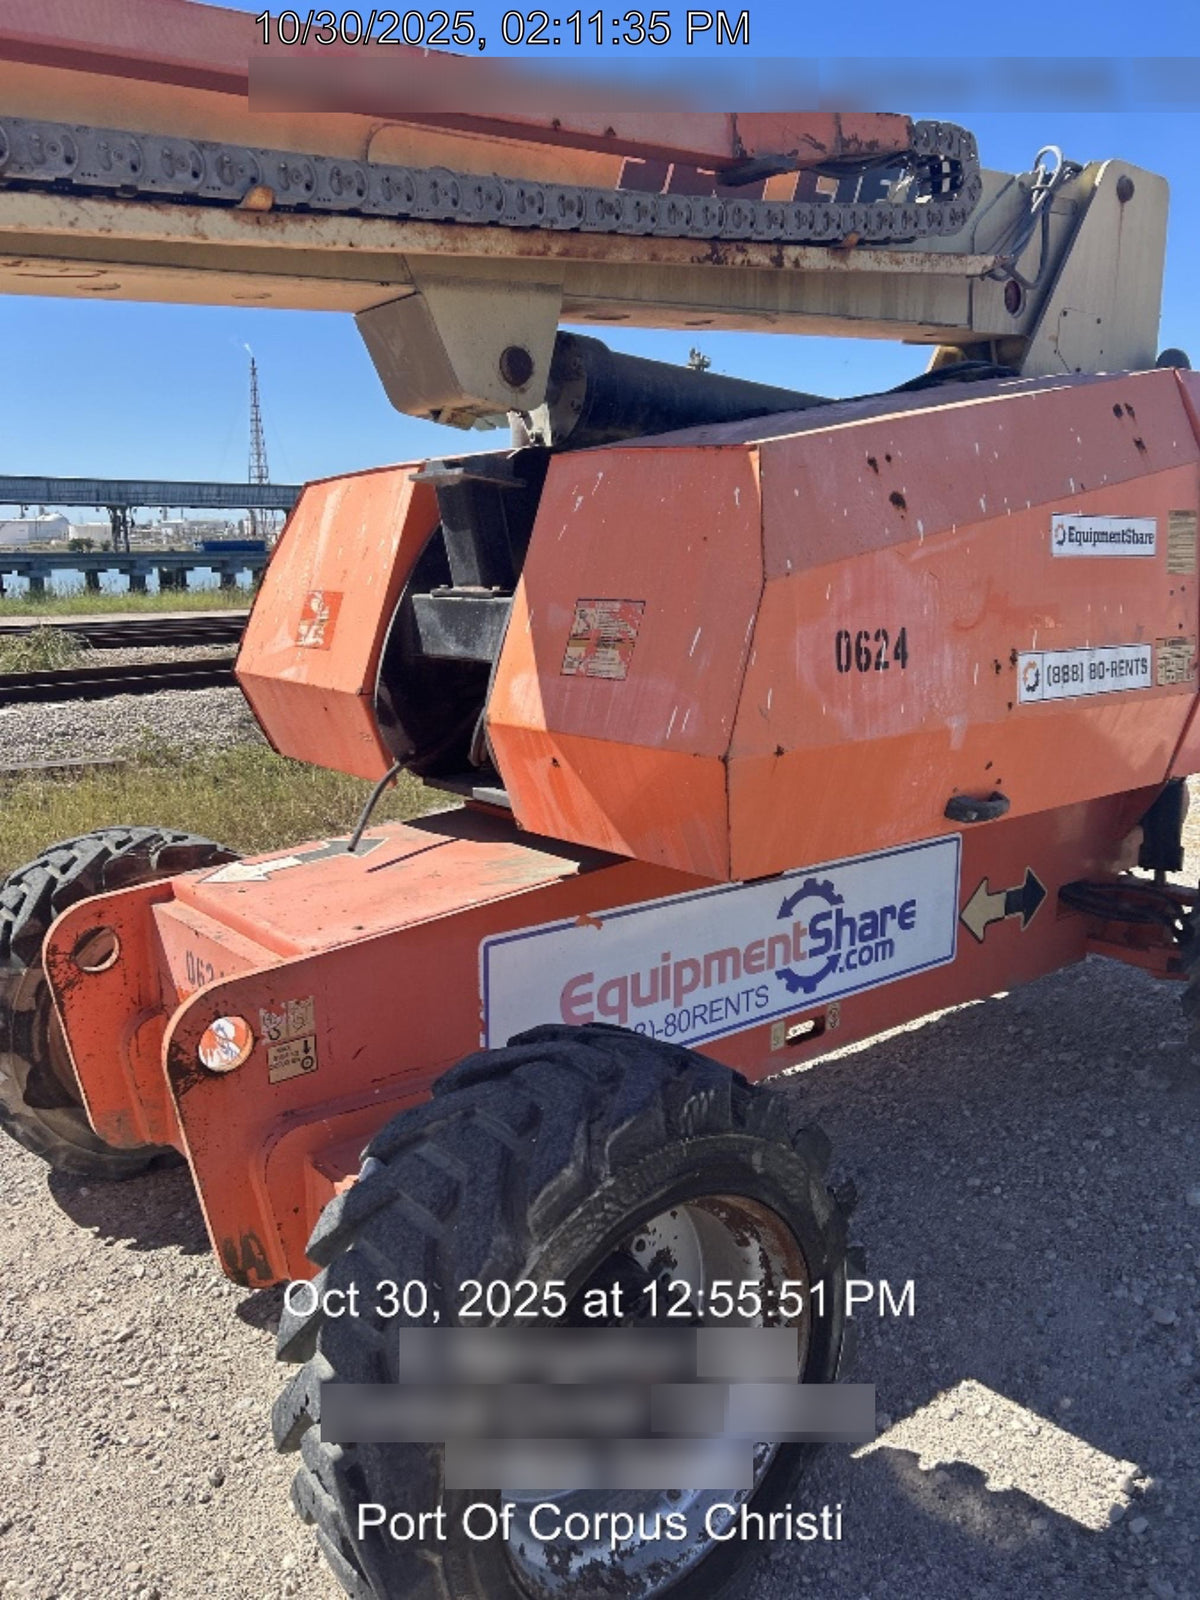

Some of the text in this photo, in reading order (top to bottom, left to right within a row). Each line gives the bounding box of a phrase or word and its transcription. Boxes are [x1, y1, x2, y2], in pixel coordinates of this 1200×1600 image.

[1067, 525, 1155, 548] EquipmentShare
[835, 626, 909, 673] 0624
[1047, 662, 1084, 687] (888)
[1089, 657, 1149, 682] 80-RENTS
[185, 949, 225, 988] 062
[559, 898, 917, 1026] EquipmentShare
[838, 937, 896, 974] .com
